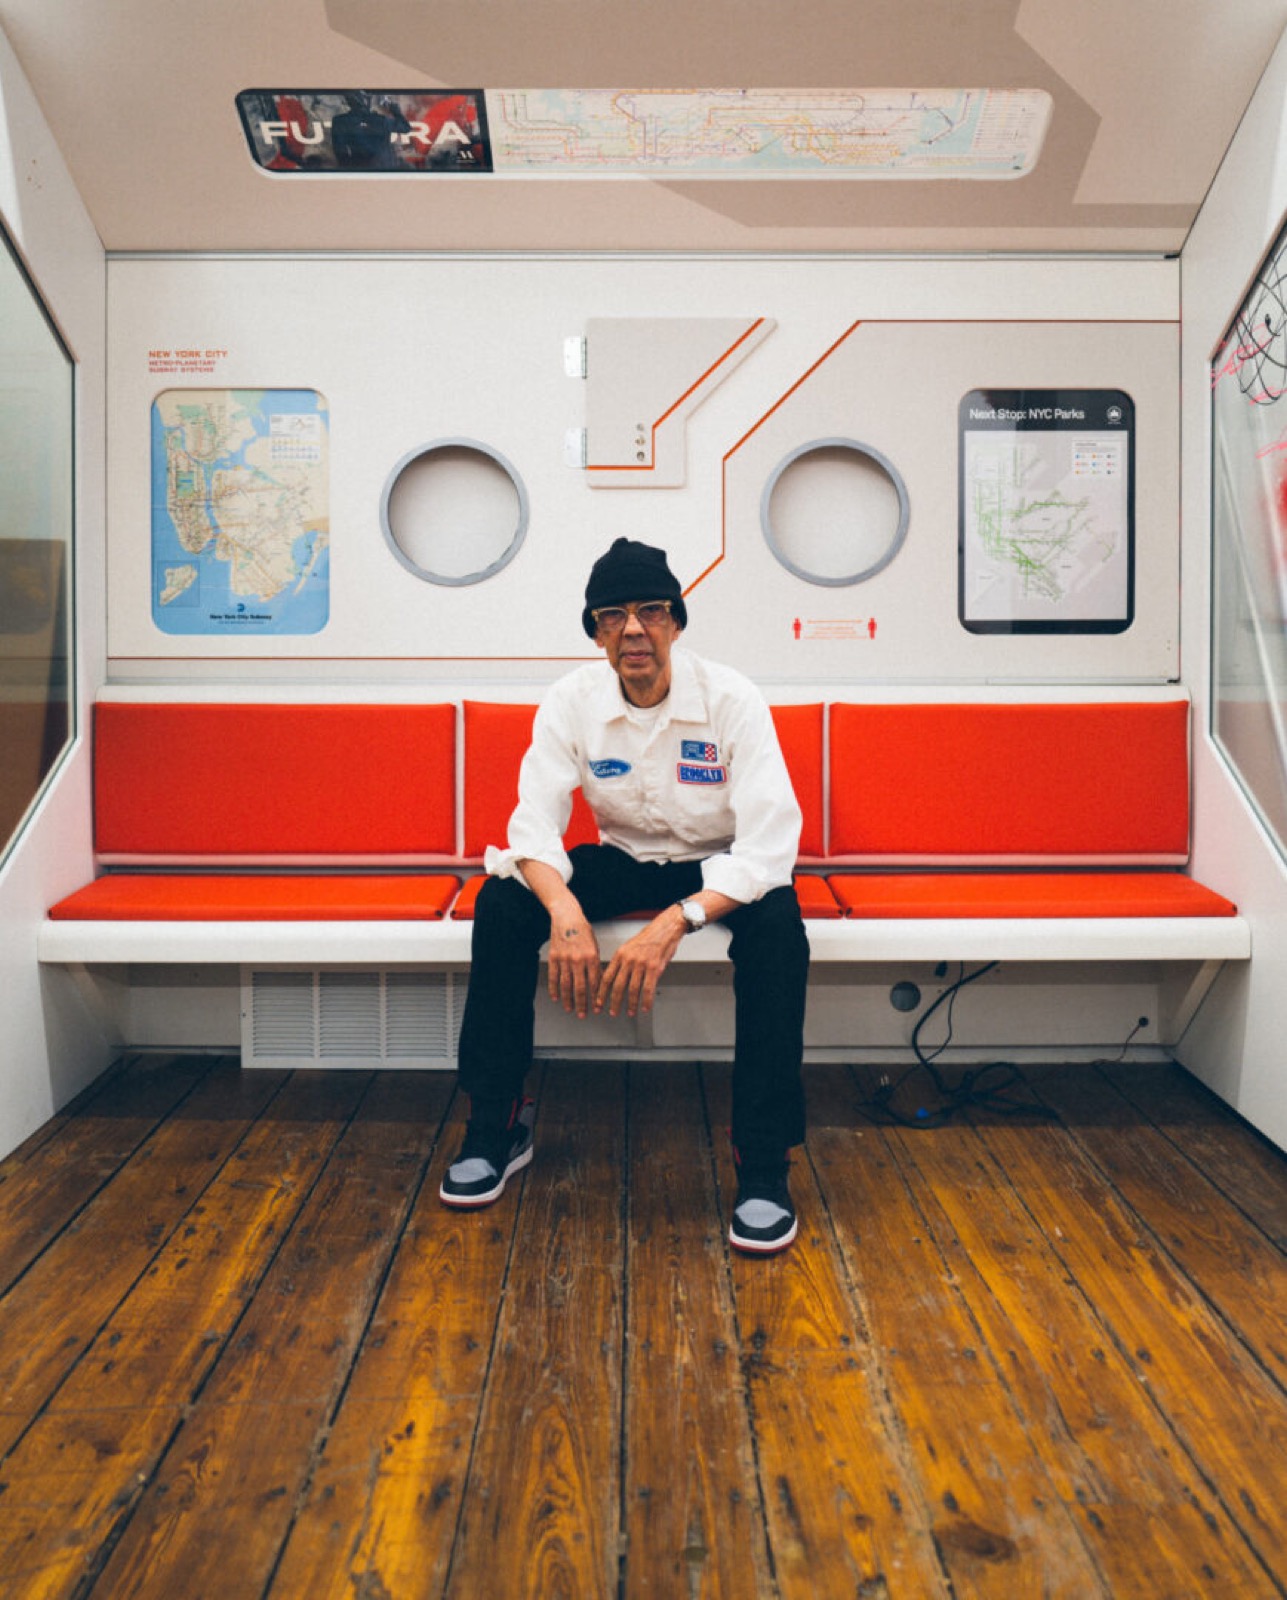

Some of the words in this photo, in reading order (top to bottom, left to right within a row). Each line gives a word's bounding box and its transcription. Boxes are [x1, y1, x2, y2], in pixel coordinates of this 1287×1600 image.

[259, 120, 472, 145] FURA
[148, 350, 171, 358] NEW
[175, 350, 201, 358] YORK
[205, 350, 228, 358] CITY
[969, 408, 996, 420] Next
[997, 408, 1027, 422] Stop:
[1028, 408, 1053, 420] NYC
[1054, 408, 1086, 420] Parks
